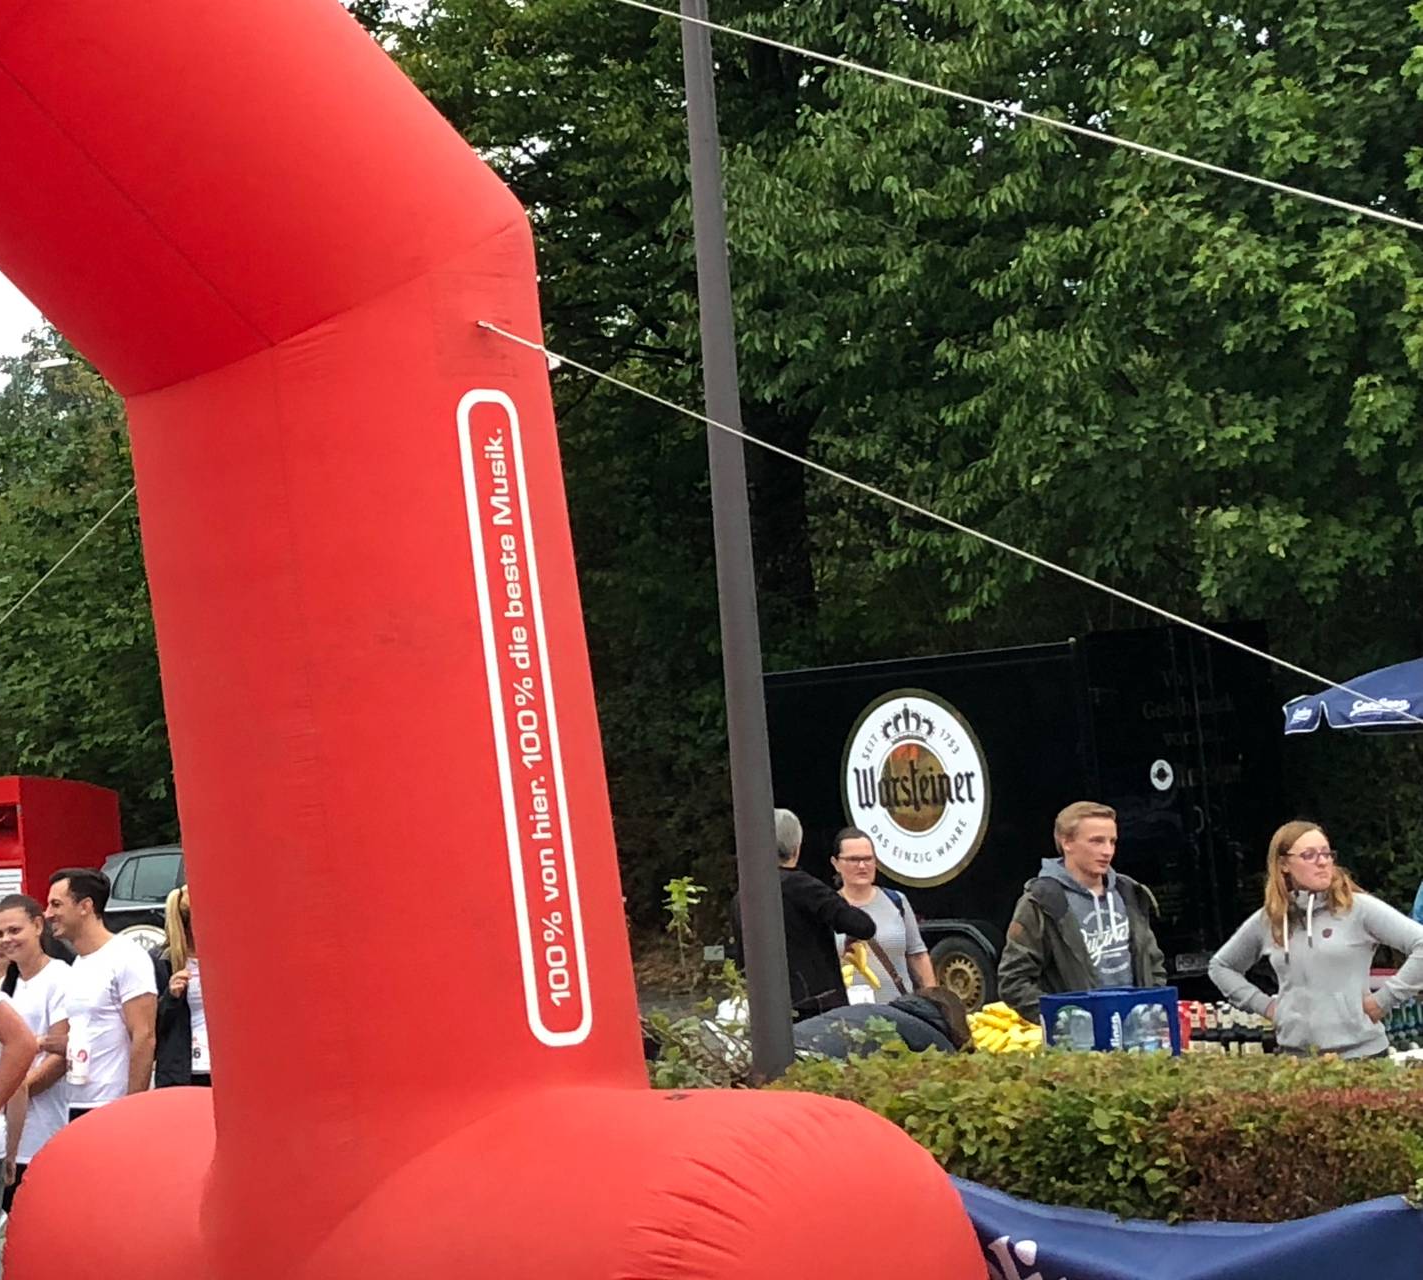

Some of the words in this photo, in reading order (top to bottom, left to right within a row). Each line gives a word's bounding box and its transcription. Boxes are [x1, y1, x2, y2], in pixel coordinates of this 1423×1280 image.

[484, 428, 513, 525] Musik.
[499, 534, 524, 617] beste
[509, 625, 531, 669] die
[862, 733, 879, 760] SEIT
[939, 728, 960, 755] 1753
[529, 775, 552, 840] hier.
[853, 760, 976, 812] Warsteiner
[871, 824, 890, 848] DAS
[892, 846, 933, 863] EINZIG
[936, 819, 967, 857] WAHRE
[540, 847, 559, 902] von
